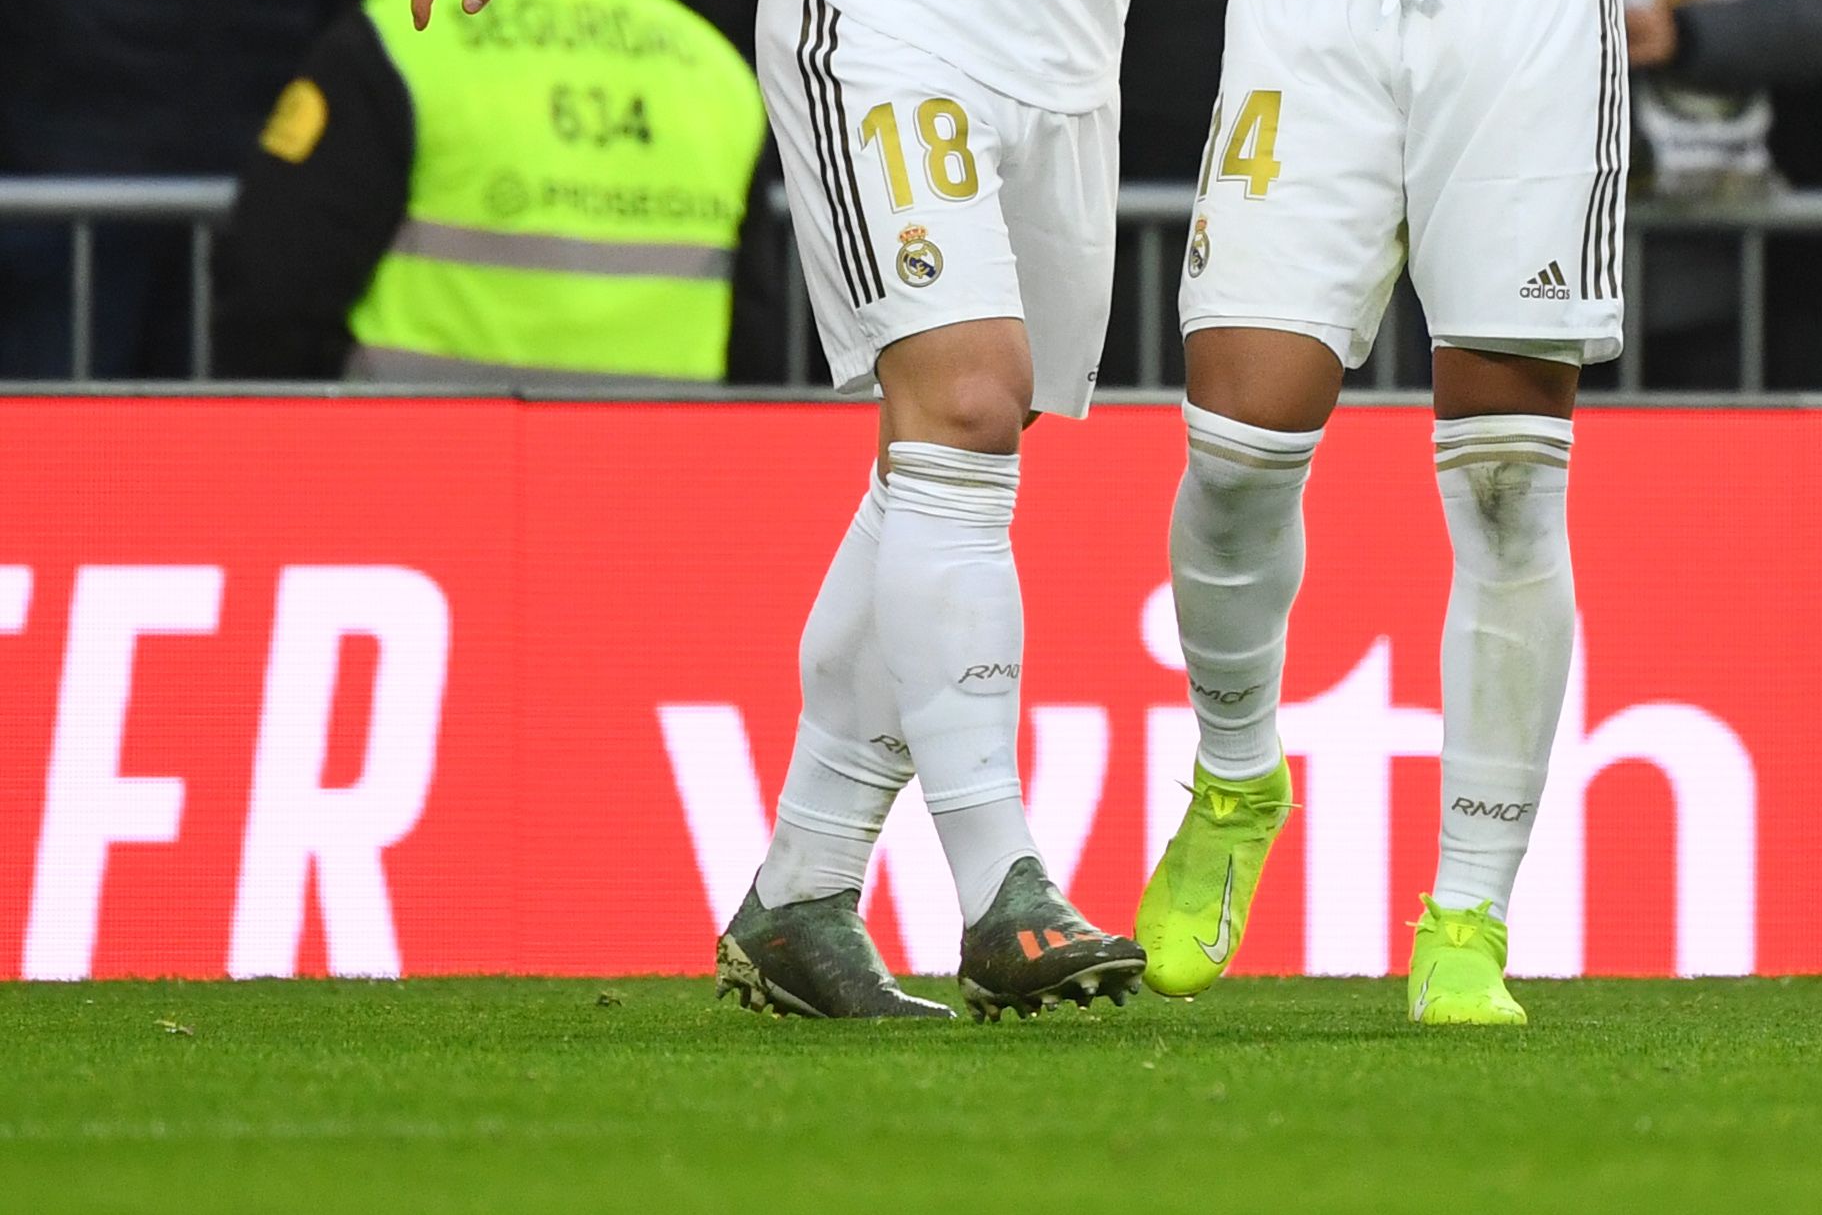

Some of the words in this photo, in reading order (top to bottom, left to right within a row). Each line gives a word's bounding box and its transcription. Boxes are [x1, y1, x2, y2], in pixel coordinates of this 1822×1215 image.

[549, 82, 655, 149] 634
[857, 97, 979, 215] 18
[1519, 284, 1571, 300] adidas
[1451, 796, 1534, 822] RMCF
